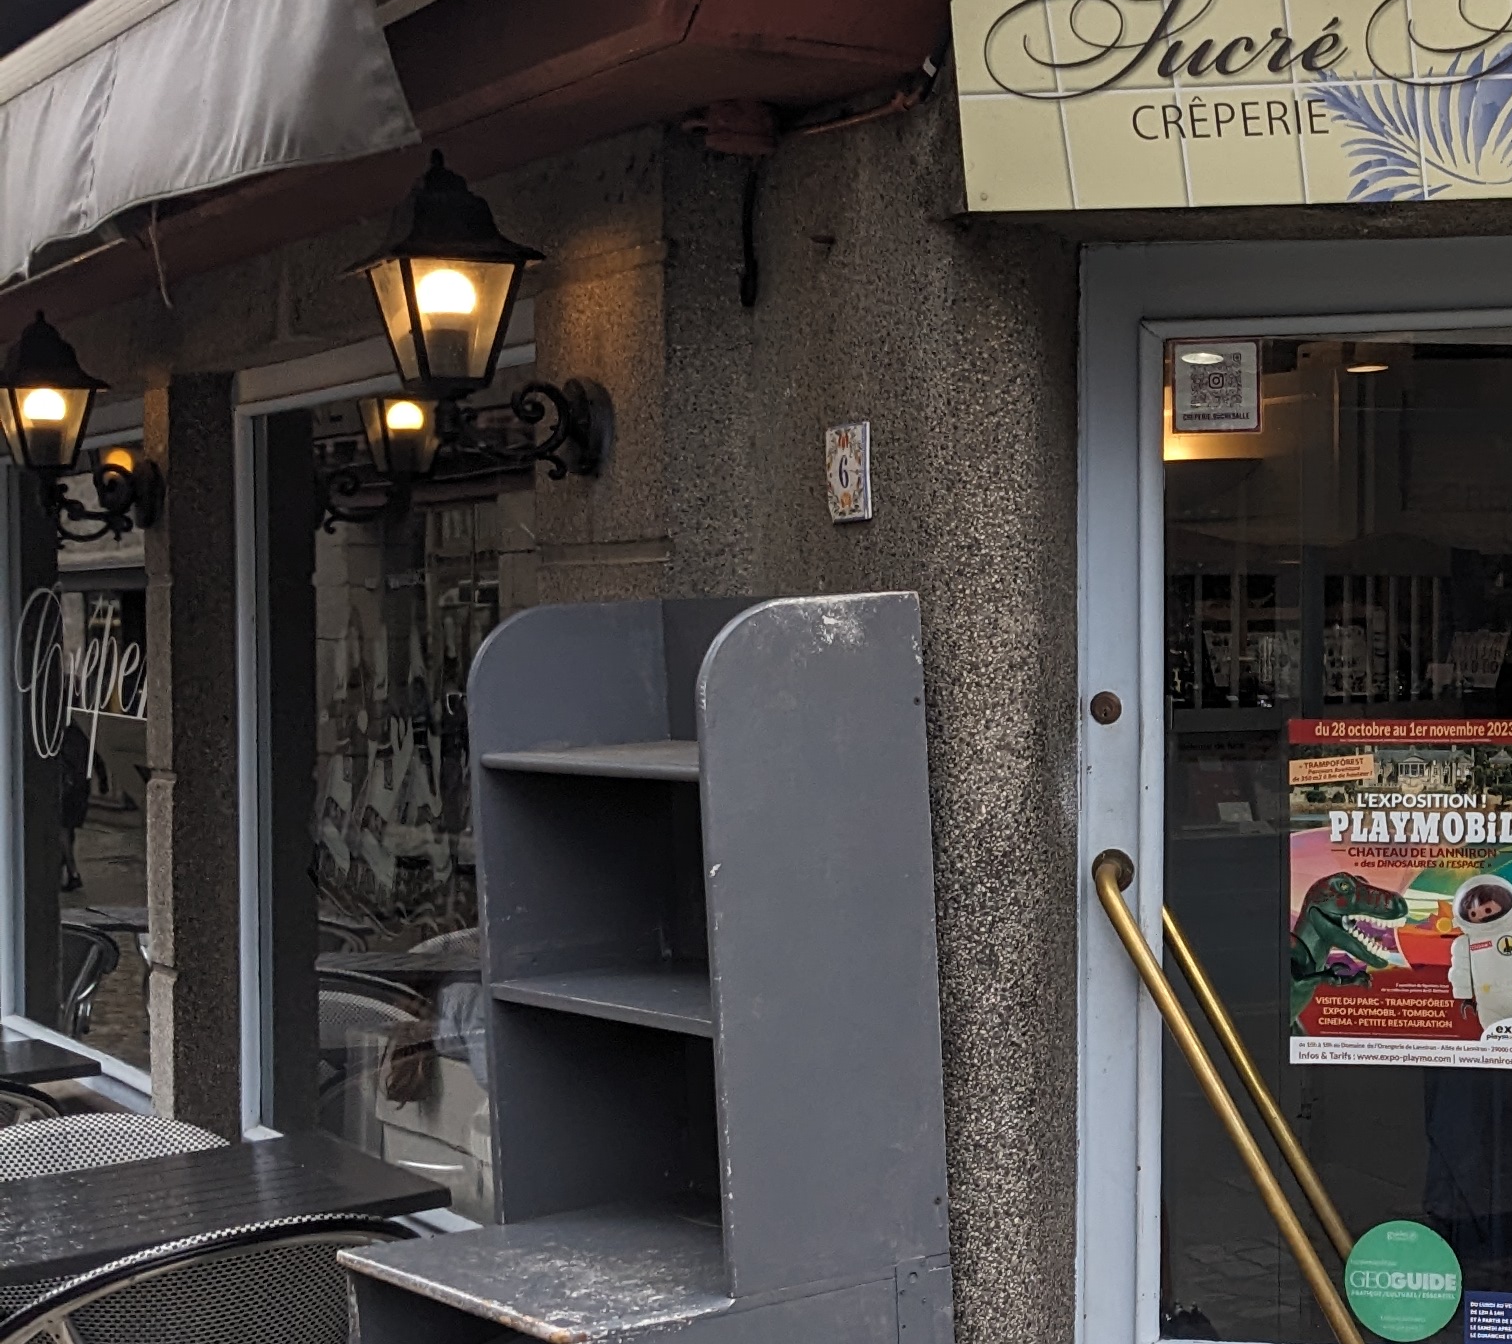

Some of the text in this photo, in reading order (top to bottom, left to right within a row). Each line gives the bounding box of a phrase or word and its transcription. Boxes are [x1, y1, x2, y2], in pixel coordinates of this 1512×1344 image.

[1132, 97, 1331, 141] CRÊPERIE
[839, 455, 849, 488] 6
[15, 588, 147, 779] Crêpe
[1315, 722, 1329, 736] du
[1331, 722, 1346, 736] 28
[1348, 722, 1391, 736] octobre
[1393, 726, 1406, 736] au
[1409, 722, 1427, 736] 1er
[1430, 723, 1484, 736] novembre
[1357, 793, 1487, 808] L'EXPOSITION !
[1348, 847, 1497, 858] CHATEAU DE LANNIRON
[1360, 859, 1485, 869] des DINOSAURES à l'ESPACE
[1343, 997, 1355, 1005] DU
[1357, 998, 1379, 1006] PARC
[1323, 1007, 1346, 1016] EXPO
[1402, 1009, 1446, 1017] TOMBOLA
[1358, 1019, 1387, 1027] PETITE
[1388, 1019, 1453, 1029] RESTAURATION
[1298, 1052, 1319, 1060] Infos
[1322, 1052, 1328, 1060] &
[1329, 1052, 1352, 1060] Tarifs
[1357, 1052, 1452, 1064] www.expo-playmo.com
[1350, 1270, 1457, 1291] GEOGUIDE
